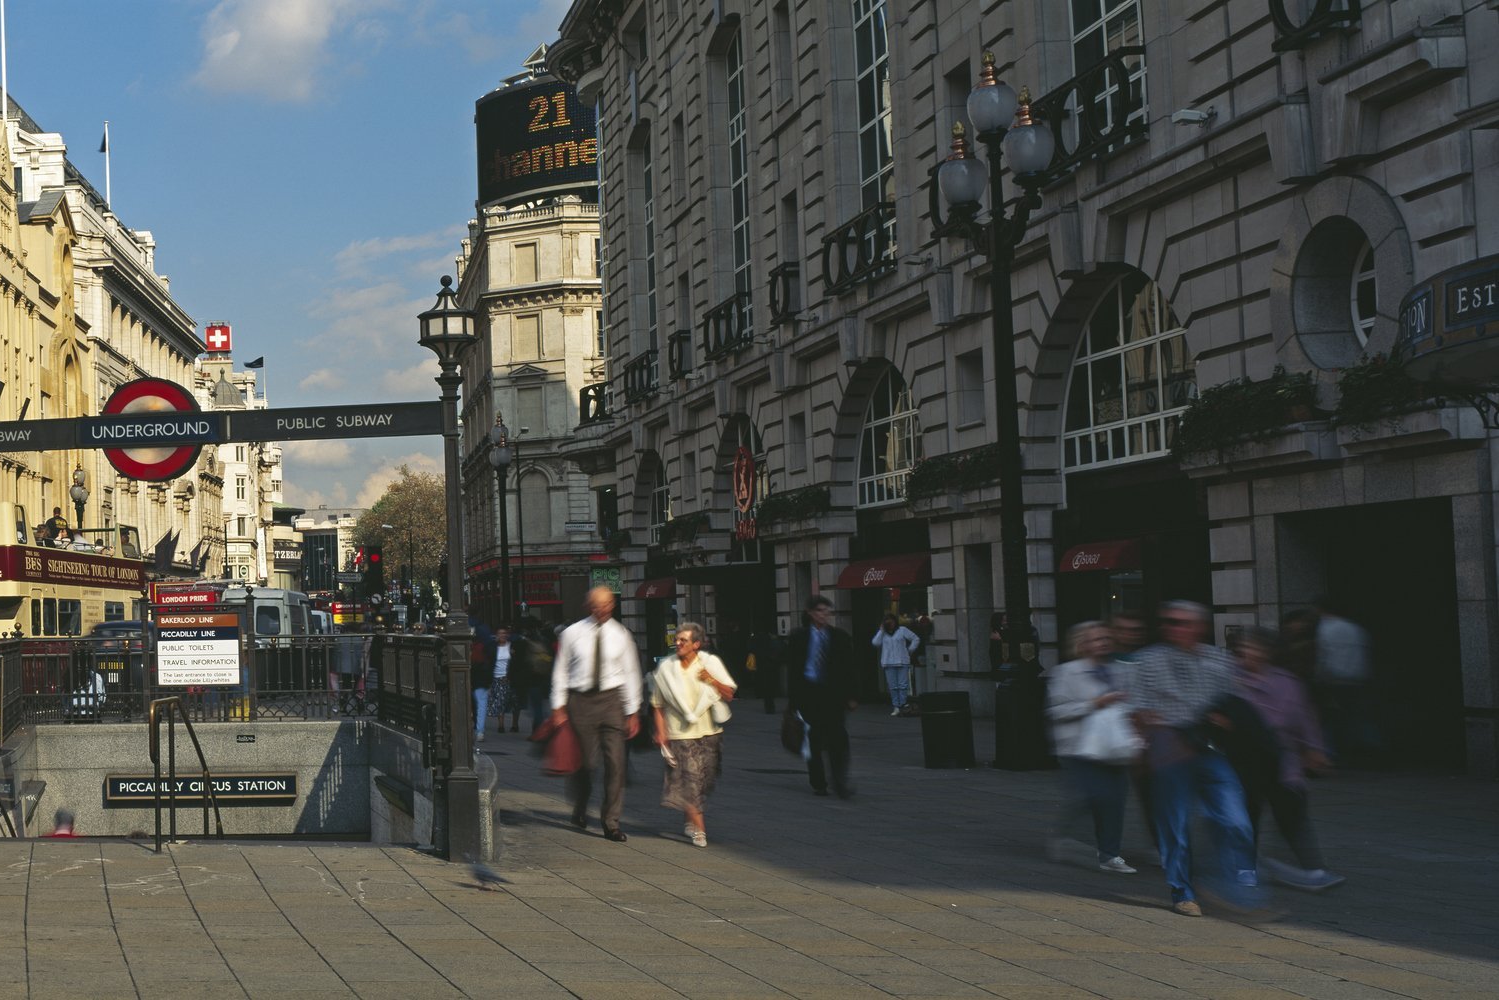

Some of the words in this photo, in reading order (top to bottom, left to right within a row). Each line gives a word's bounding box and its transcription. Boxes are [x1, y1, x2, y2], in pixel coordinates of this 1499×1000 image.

[528, 92, 570, 132] 21
[486, 138, 598, 184] hanne
[1456, 283, 1497, 314] EST
[92, 421, 210, 439] UNDERGROUND
[277, 417, 326, 430] PUBLIC
[336, 414, 393, 428] SUBWAY
[25, 556, 42, 571] BUS
[48, 559, 90, 575] SIGHTSEEING
[91, 564, 108, 578] TOUR
[108, 566, 115, 579] OF
[117, 568, 139, 581] LONDON
[119, 782, 184, 793] PICCAILY
[189, 781, 231, 792] CIUS
[237, 780, 286, 791] STATION
